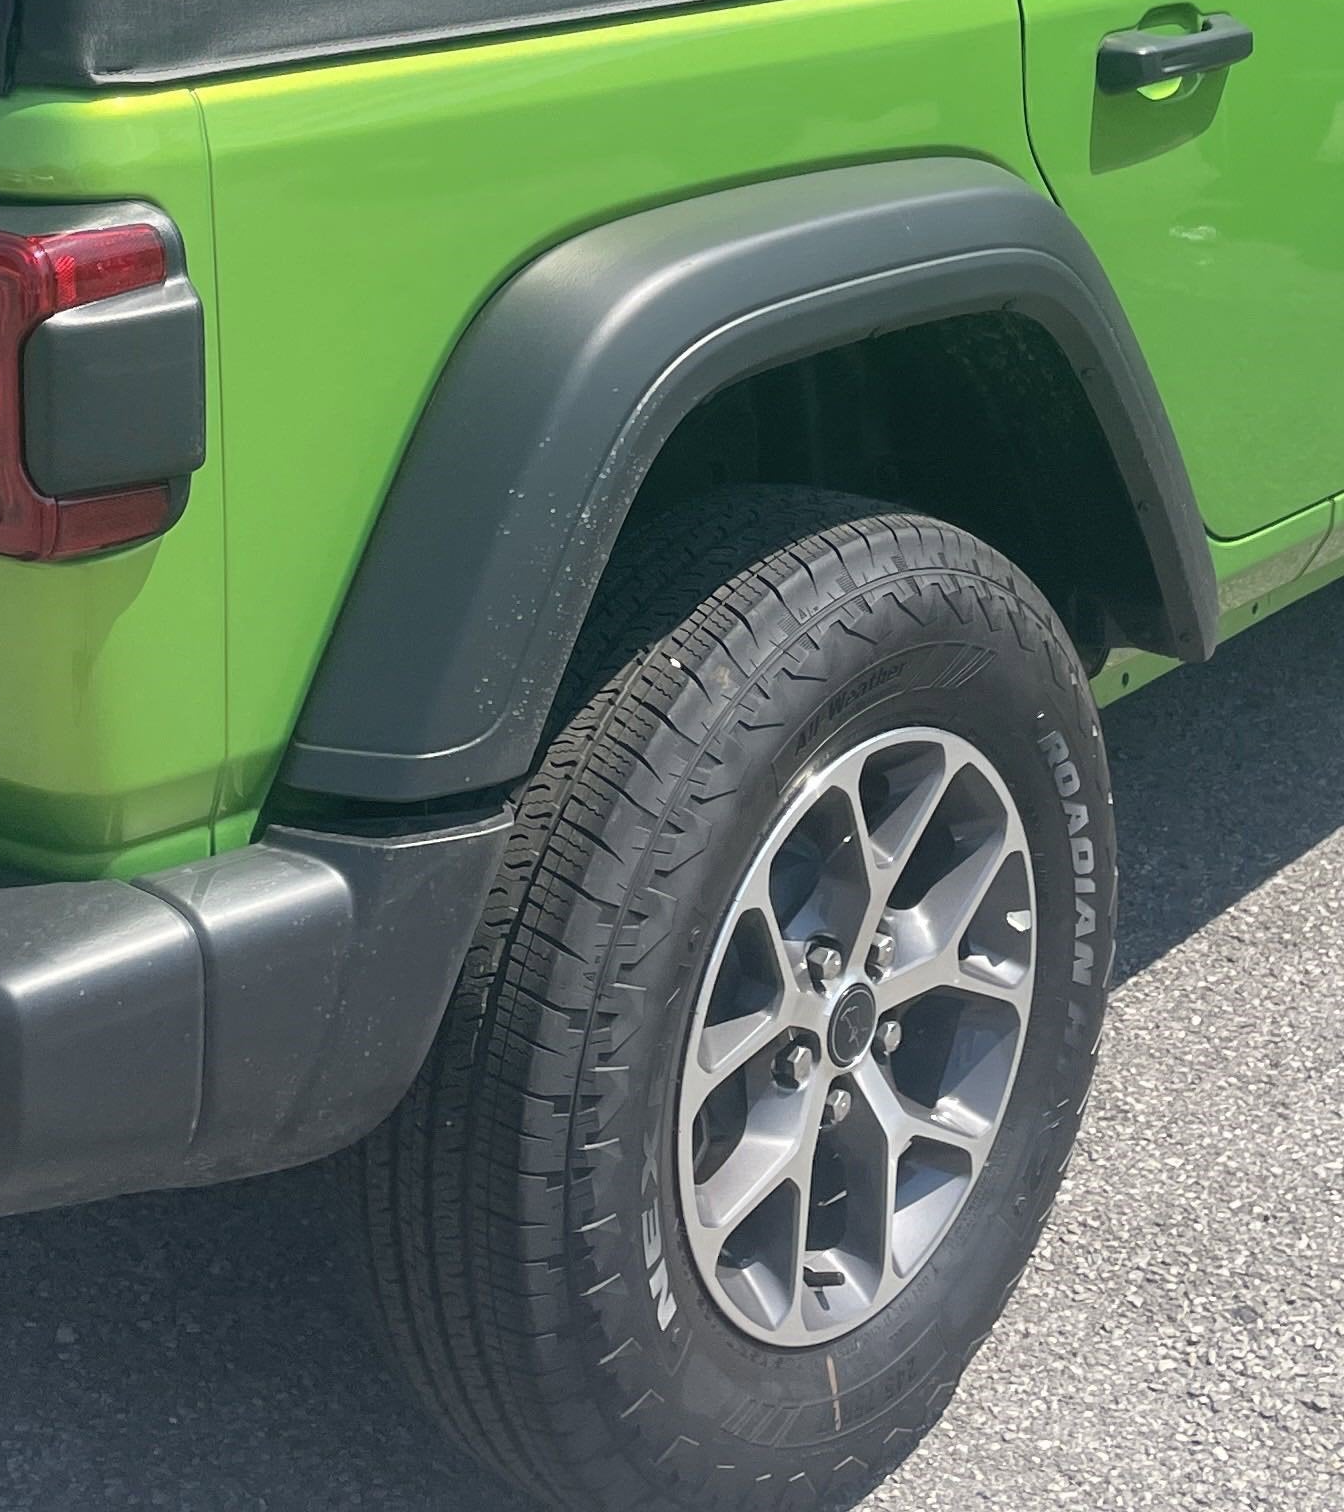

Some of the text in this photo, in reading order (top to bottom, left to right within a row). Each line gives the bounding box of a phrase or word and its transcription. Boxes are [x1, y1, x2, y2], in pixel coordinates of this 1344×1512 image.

[827, 662, 907, 720] Weather
[1036, 729, 1096, 986] ROADIAN
[641, 1078, 678, 1332] NEX
